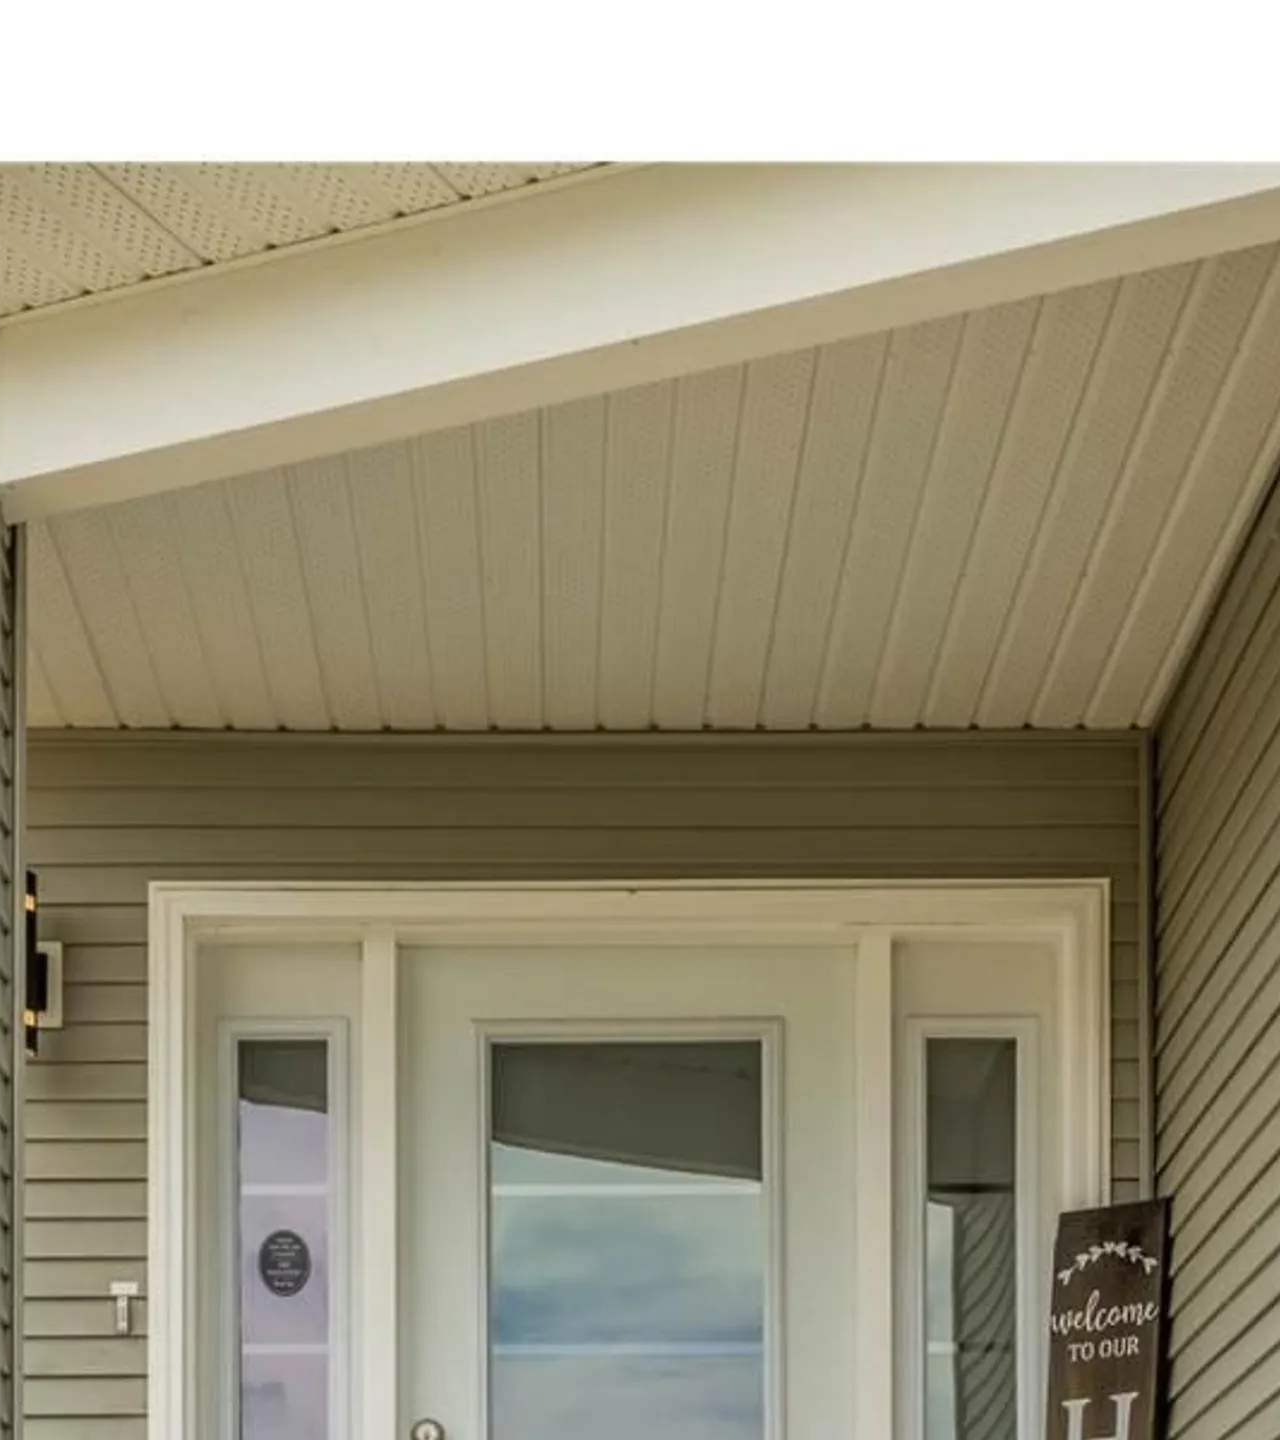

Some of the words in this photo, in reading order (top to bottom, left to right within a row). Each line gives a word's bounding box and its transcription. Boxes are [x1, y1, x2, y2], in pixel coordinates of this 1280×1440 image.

[1050, 1289, 1160, 1336] welcome
[1068, 1341, 1096, 1362] TO
[1099, 1335, 1140, 1359] OUR
